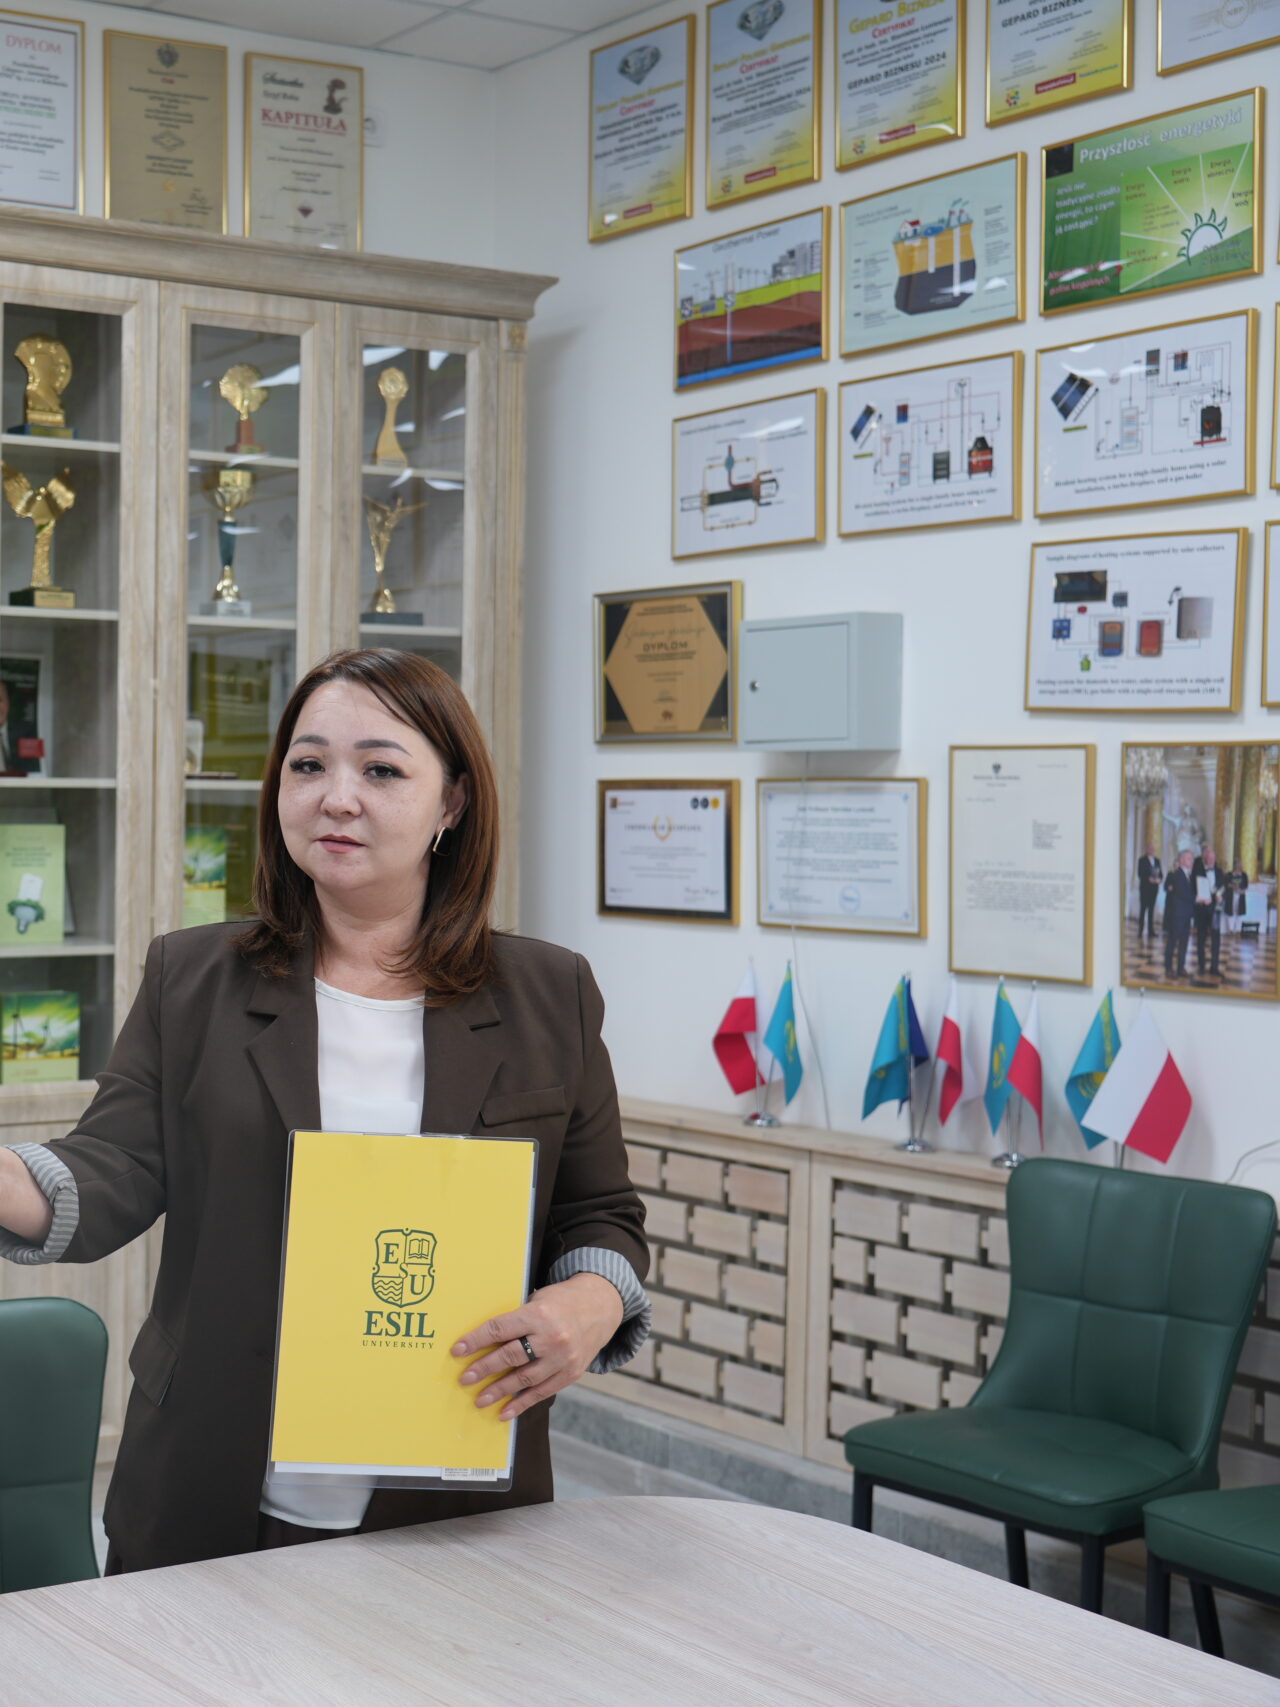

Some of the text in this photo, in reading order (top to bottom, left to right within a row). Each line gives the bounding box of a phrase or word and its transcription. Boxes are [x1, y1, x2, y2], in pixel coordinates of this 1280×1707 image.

[1001, 9, 1039, 28] GEPARD
[5, 34, 62, 54] DYPLOM
[643, 641, 688, 652] DYPLOM
[363, 1310, 435, 1338] ESIL
[362, 1340, 434, 1349] UNIVERSITY
